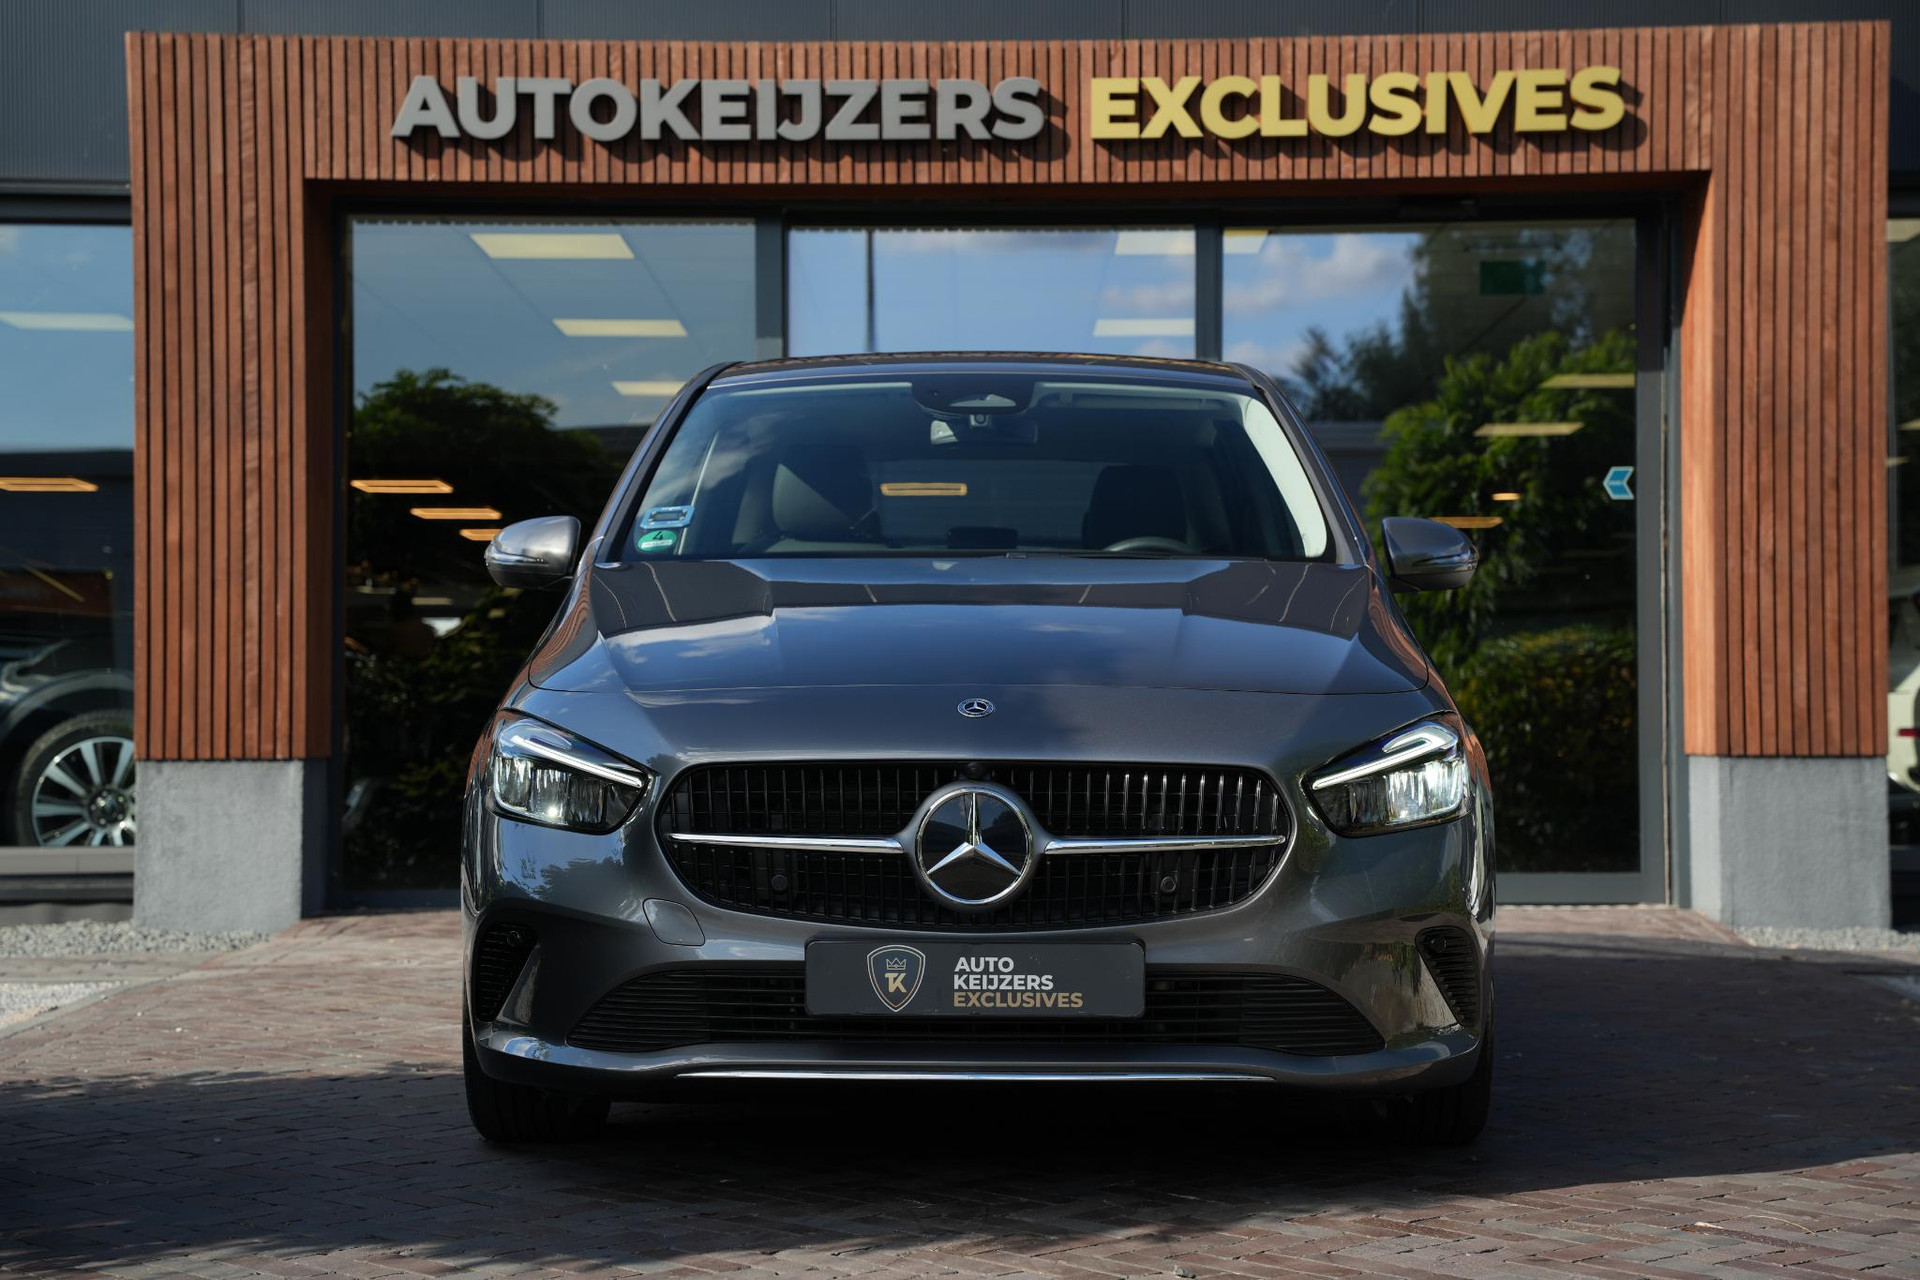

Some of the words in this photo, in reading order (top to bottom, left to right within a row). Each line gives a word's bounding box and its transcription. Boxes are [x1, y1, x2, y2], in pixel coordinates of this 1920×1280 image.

[391, 75, 1045, 142] AUTOKEIJZERS
[1090, 65, 1626, 139] EXCLUSIVES
[954, 957, 1014, 973] AUTO
[953, 974, 1054, 991] KEIJZERS
[953, 991, 1083, 1008] EXCLUSIVES
